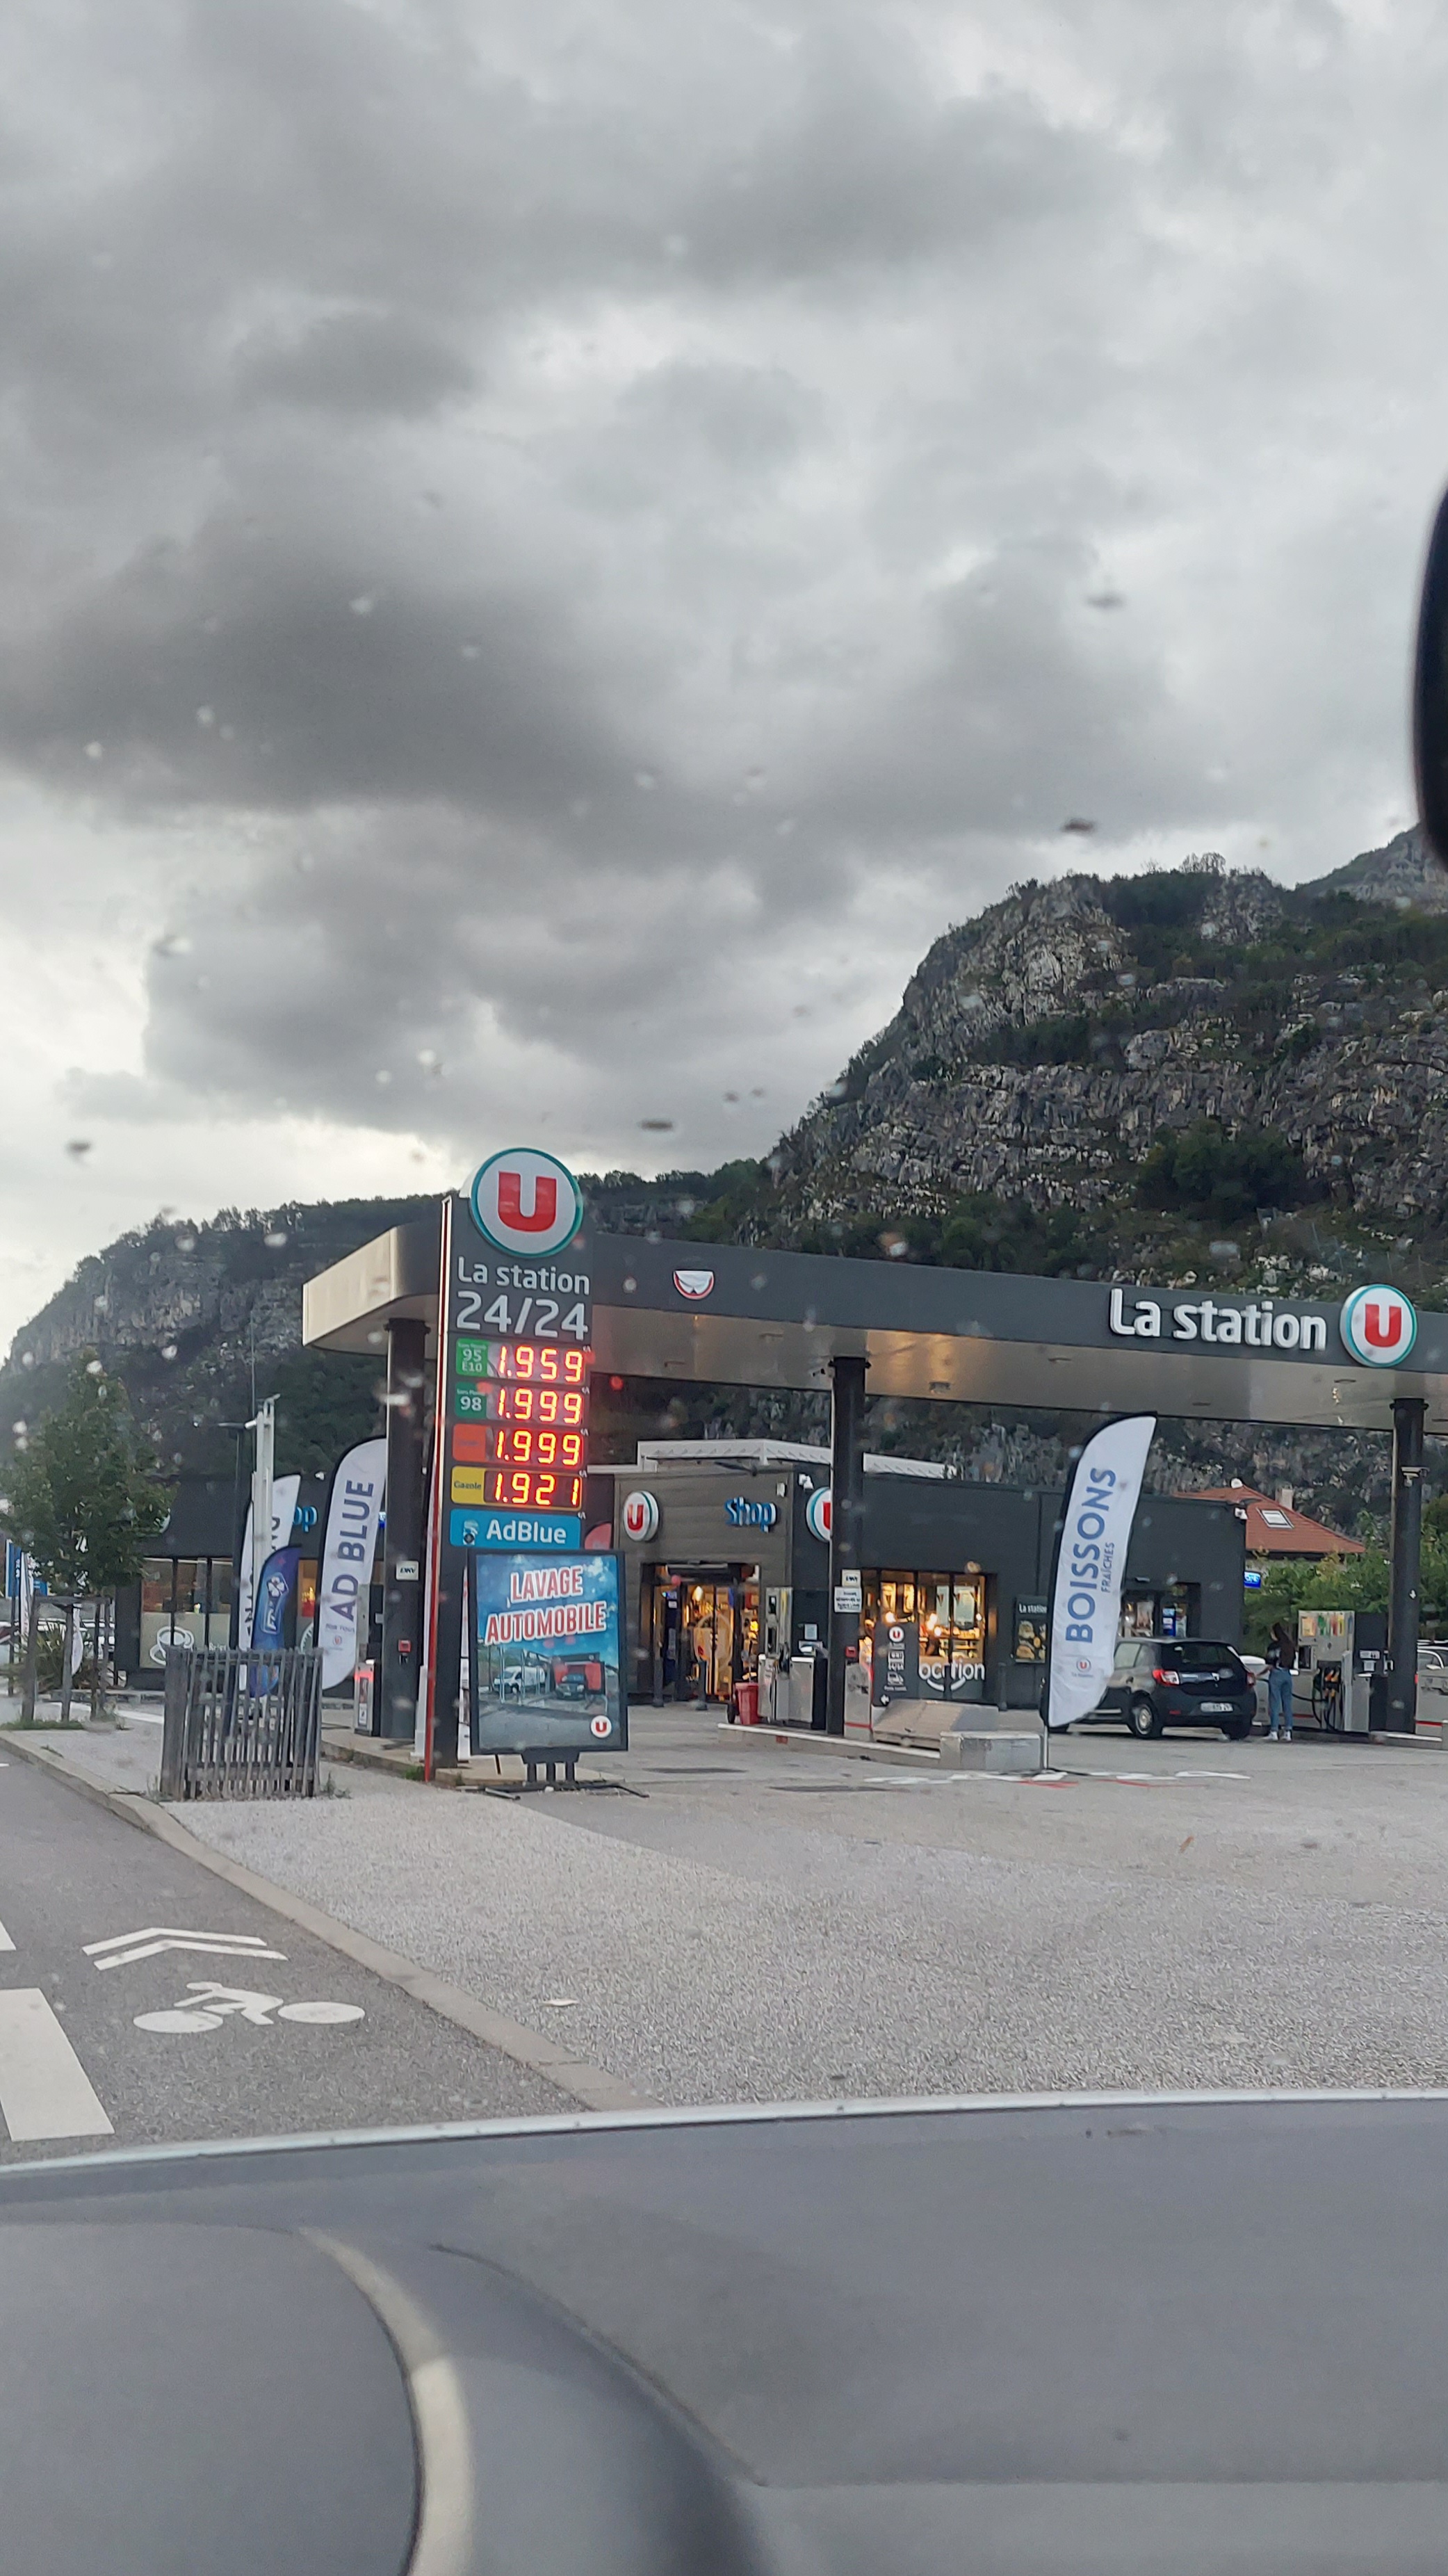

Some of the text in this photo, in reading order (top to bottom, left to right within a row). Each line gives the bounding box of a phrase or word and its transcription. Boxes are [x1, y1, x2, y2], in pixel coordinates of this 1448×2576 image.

[498, 1172, 557, 1232] U
[458, 1256, 589, 1295] La station
[456, 1290, 589, 1341] 24/24
[1109, 1288, 1327, 1351] La station
[1365, 1303, 1402, 1348] U
[462, 1349, 482, 1362] 95
[498, 1345, 583, 1383] 1.959
[460, 1396, 482, 1411] 98
[498, 1388, 582, 1425] 1.999
[496, 1430, 580, 1466] 1.999
[454, 1480, 482, 1491] Gazole
[495, 1472, 579, 1506] 1.921
[293, 1506, 318, 1532] op
[337, 1480, 374, 1562] BLUE
[486, 1518, 567, 1544] AdBlue
[627, 1504, 644, 1531] U
[724, 1496, 777, 1532] Shop
[1065, 1468, 1116, 1644] BOISSONS
[330, 1573, 359, 1622] AD
[511, 1566, 583, 1603] LAVAGE
[485, 1601, 607, 1646] AUTOMOBILE
[596, 1722, 607, 1732] U
